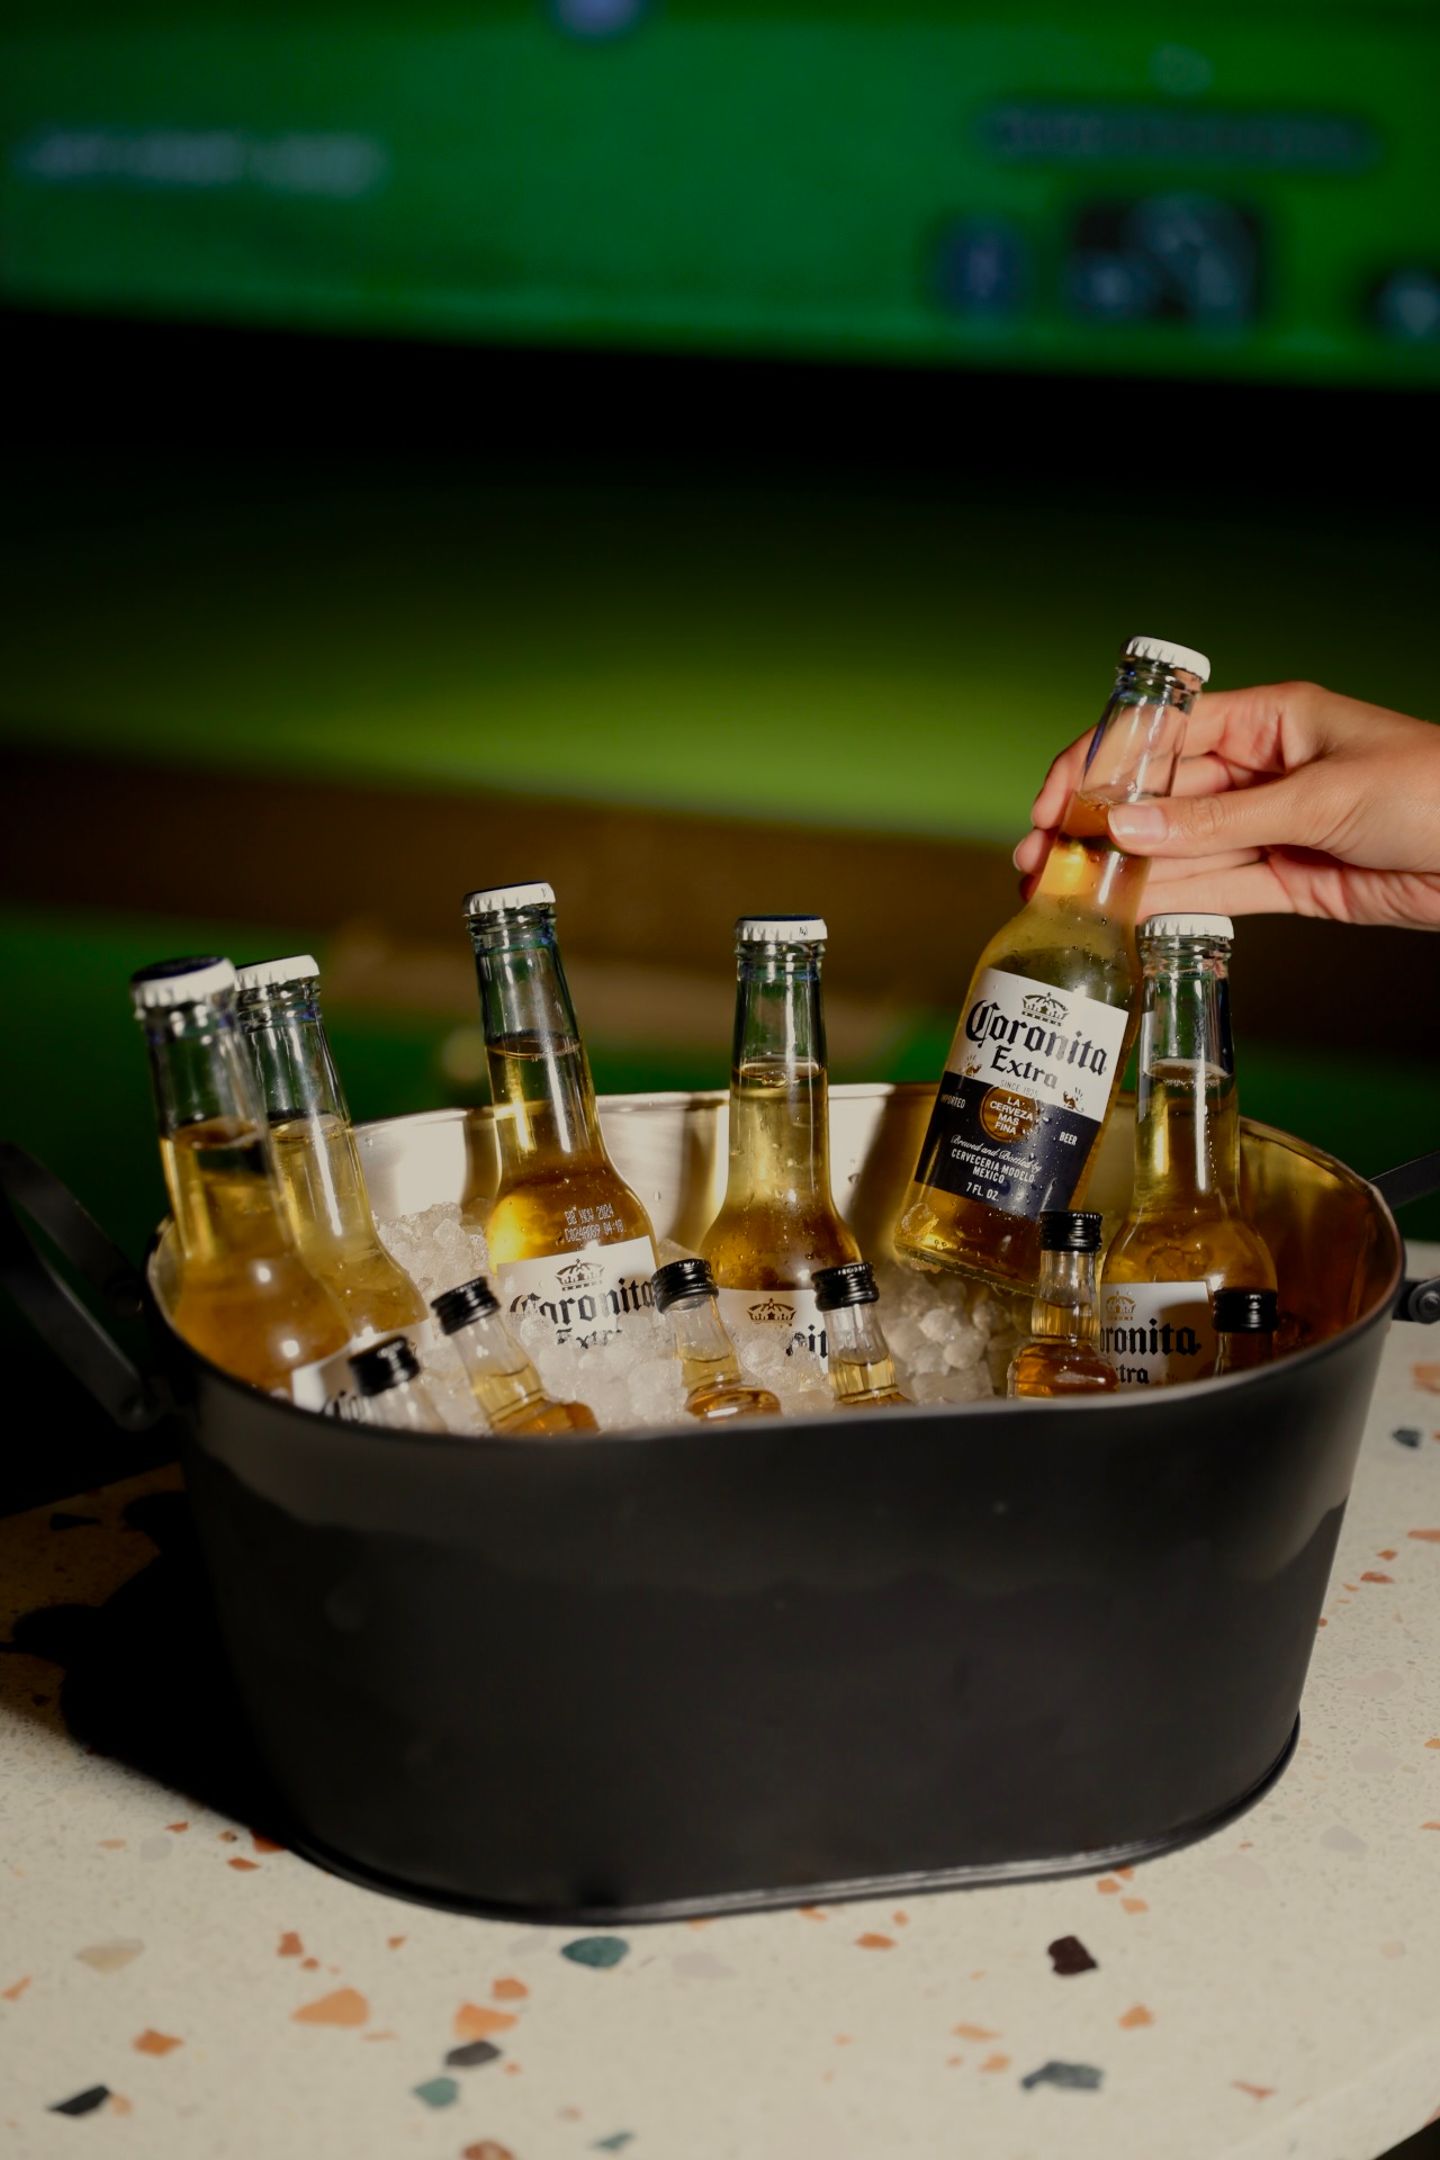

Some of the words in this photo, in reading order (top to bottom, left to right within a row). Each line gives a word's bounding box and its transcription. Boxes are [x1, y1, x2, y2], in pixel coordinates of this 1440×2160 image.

[965, 1000, 1107, 1076] Coronita
[990, 1045, 1058, 1089] Extra
[990, 1101, 1033, 1120] CERVEZA
[1007, 1097, 1020, 1108] LA
[994, 1121, 1016, 1135] FINA
[998, 1112, 1020, 1126] MAS
[950, 1134, 984, 1151] Brewed
[981, 1148, 1000, 1157] and
[1059, 1131, 1078, 1146] BEER
[951, 1148, 1000, 1172] CERVECERIA
[1001, 1164, 1035, 1183] MODELO
[972, 1166, 1005, 1184] MEXICO
[966, 1182, 973, 1192] 7
[972, 1184, 984, 1197] FL.
[986, 1189, 1000, 1201] OZ.
[1100, 1318, 1197, 1356] oronita
[1115, 1364, 1150, 1384] tra
